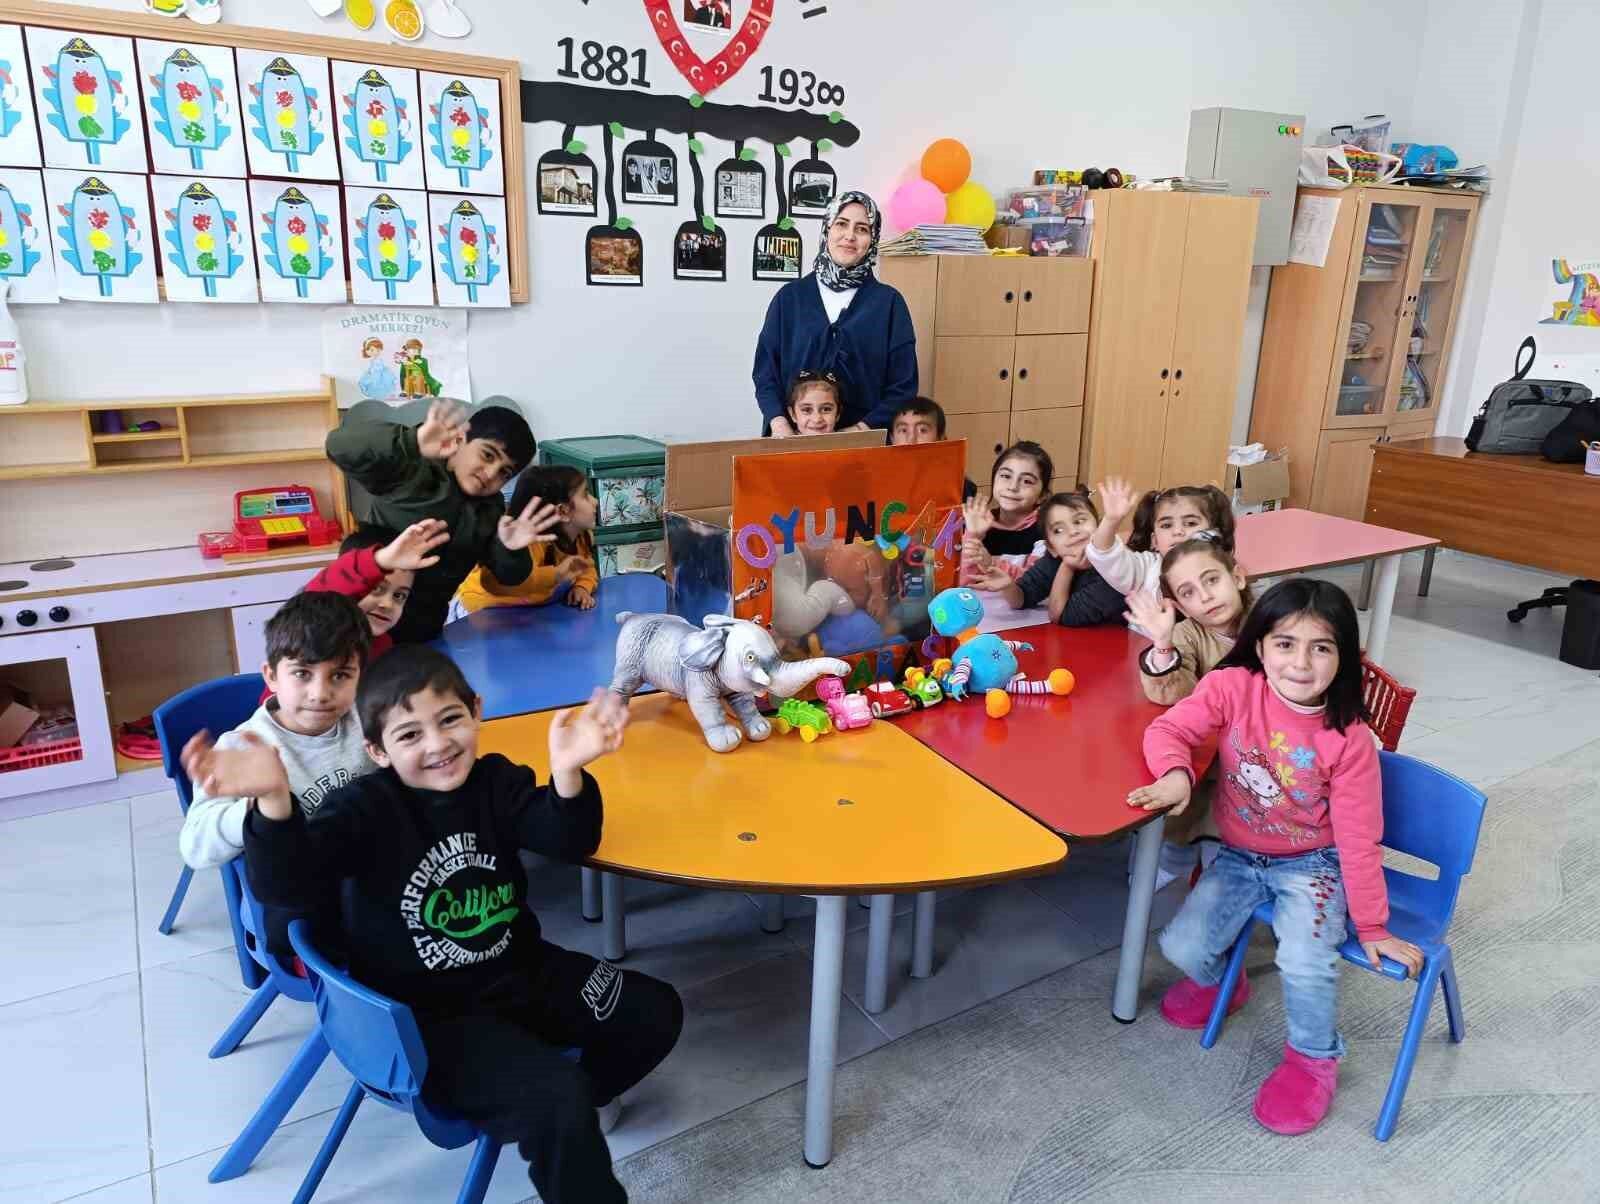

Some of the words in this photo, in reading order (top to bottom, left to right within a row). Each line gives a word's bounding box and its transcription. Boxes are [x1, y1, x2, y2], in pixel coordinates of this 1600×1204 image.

[557, 37, 651, 88] 1881
[341, 312, 410, 328] DRAMATİK
[414, 314, 449, 329] OYUN
[369, 322, 424, 334] MERKEZİ
[736, 500, 965, 569] OYUNCAK
[400, 832, 477, 931] PERFORMANCE
